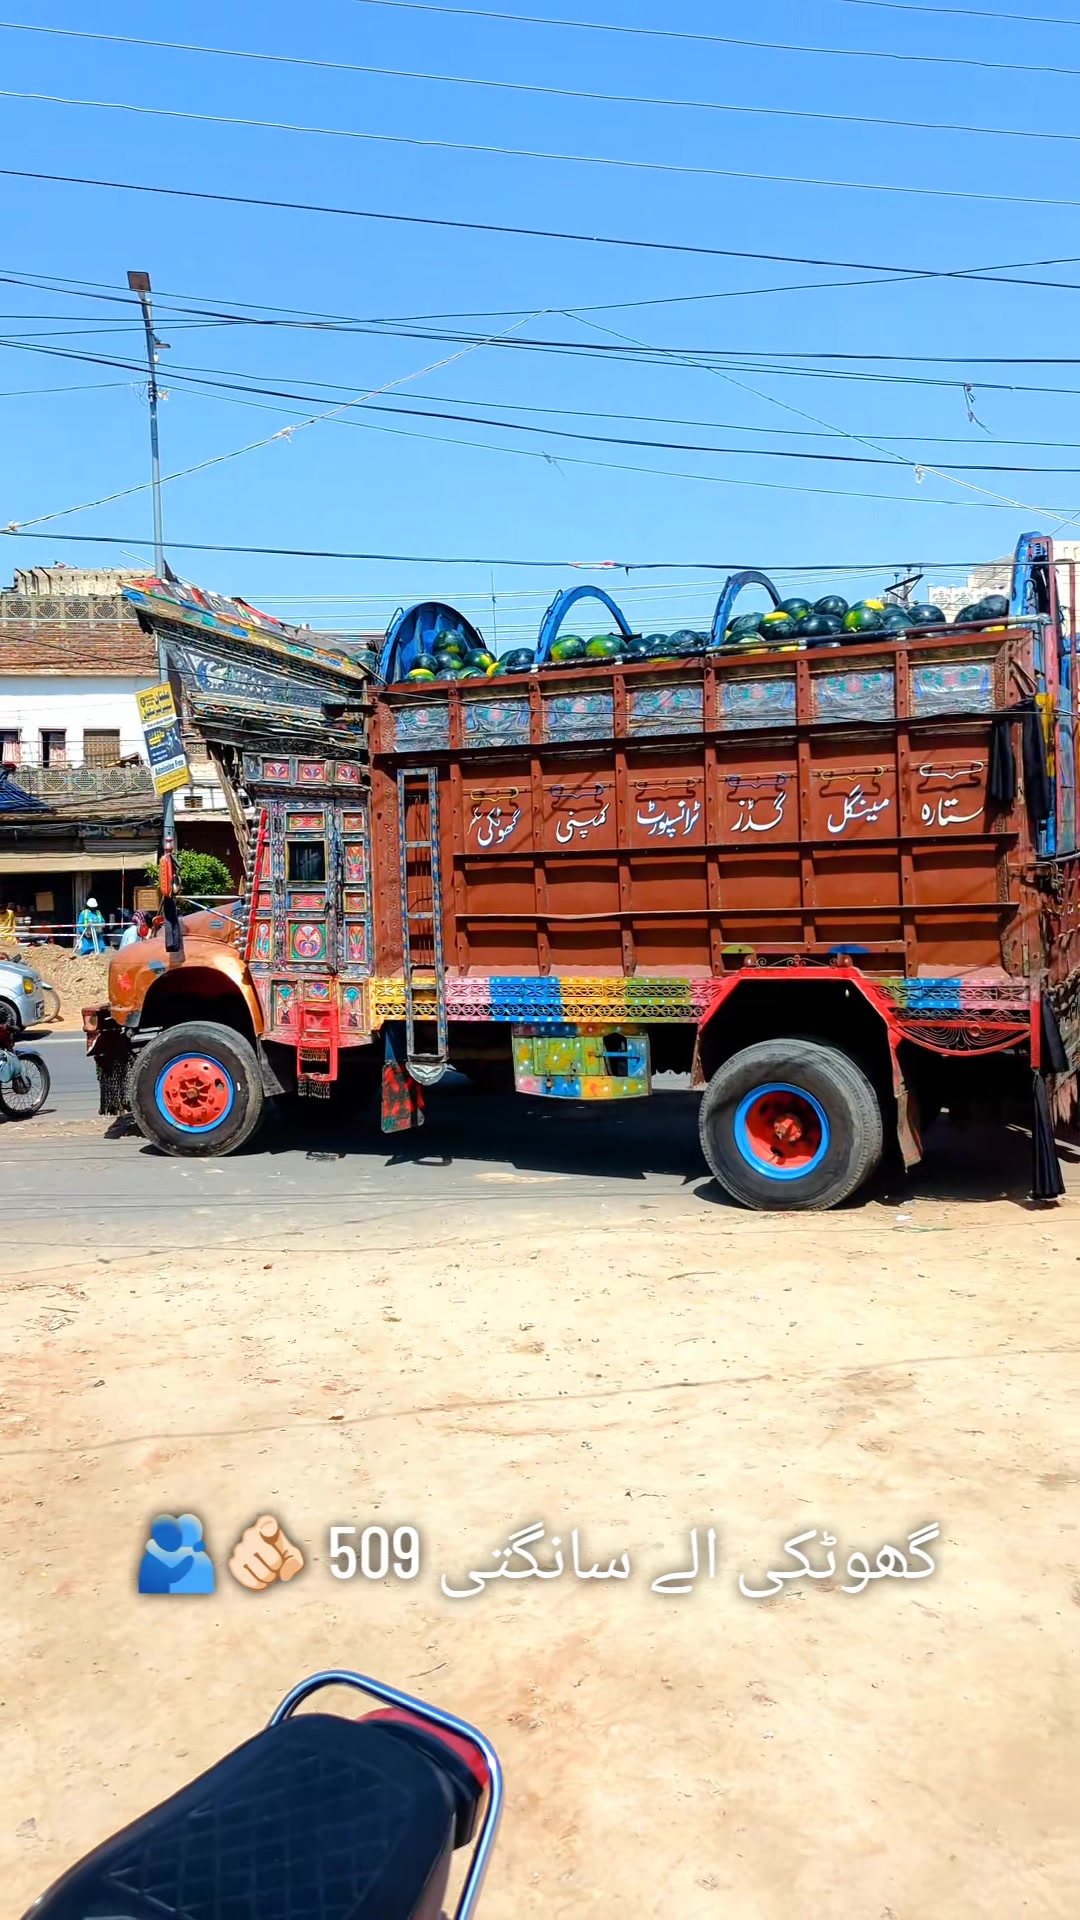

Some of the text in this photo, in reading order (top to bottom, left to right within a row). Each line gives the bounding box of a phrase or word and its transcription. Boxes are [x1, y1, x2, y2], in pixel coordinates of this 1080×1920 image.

[155, 762, 175, 775] Admission
[477, 806, 522, 848] گھوٹکی
[555, 802, 611, 844] کمپنی
[635, 799, 702, 838] ٹرانسپورٹ
[730, 790, 787, 832] گڈز
[826, 783, 891, 834] مینگل
[920, 796, 985, 828] ستارہ
